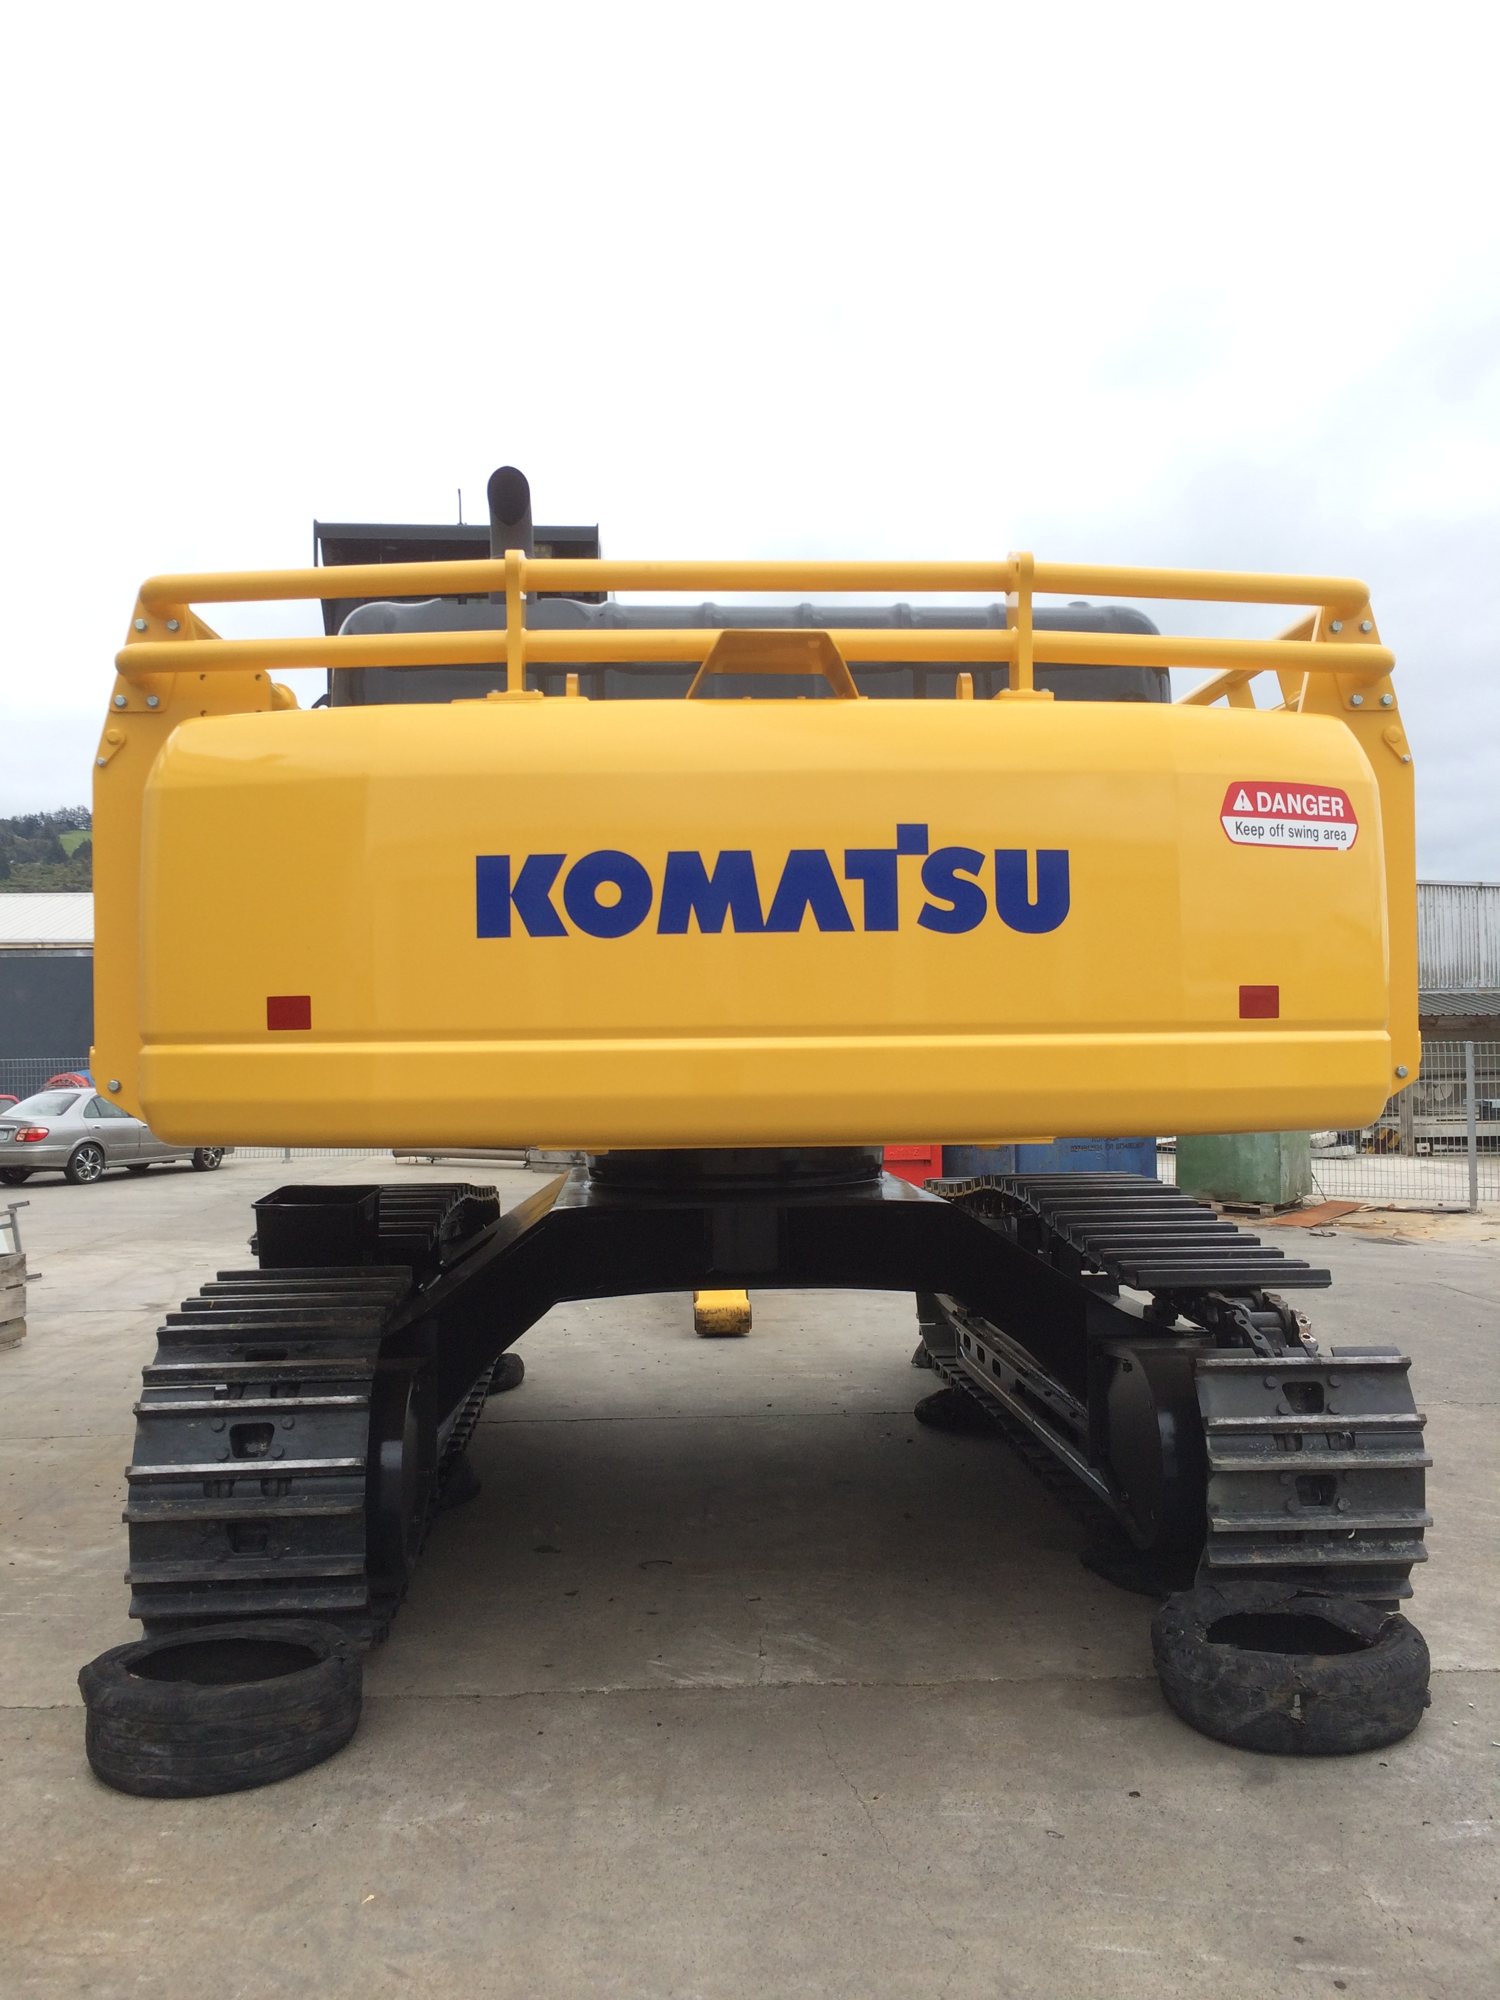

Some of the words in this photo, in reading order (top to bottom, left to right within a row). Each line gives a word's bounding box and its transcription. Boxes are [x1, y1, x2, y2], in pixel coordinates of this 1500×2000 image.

[1256, 791, 1344, 817] DANGER
[1235, 821, 1265, 839] Keep
[1269, 824, 1285, 837] off
[1288, 825, 1319, 842] swing
[1323, 829, 1347, 841] area
[475, 823, 1071, 939] KOMATSU
